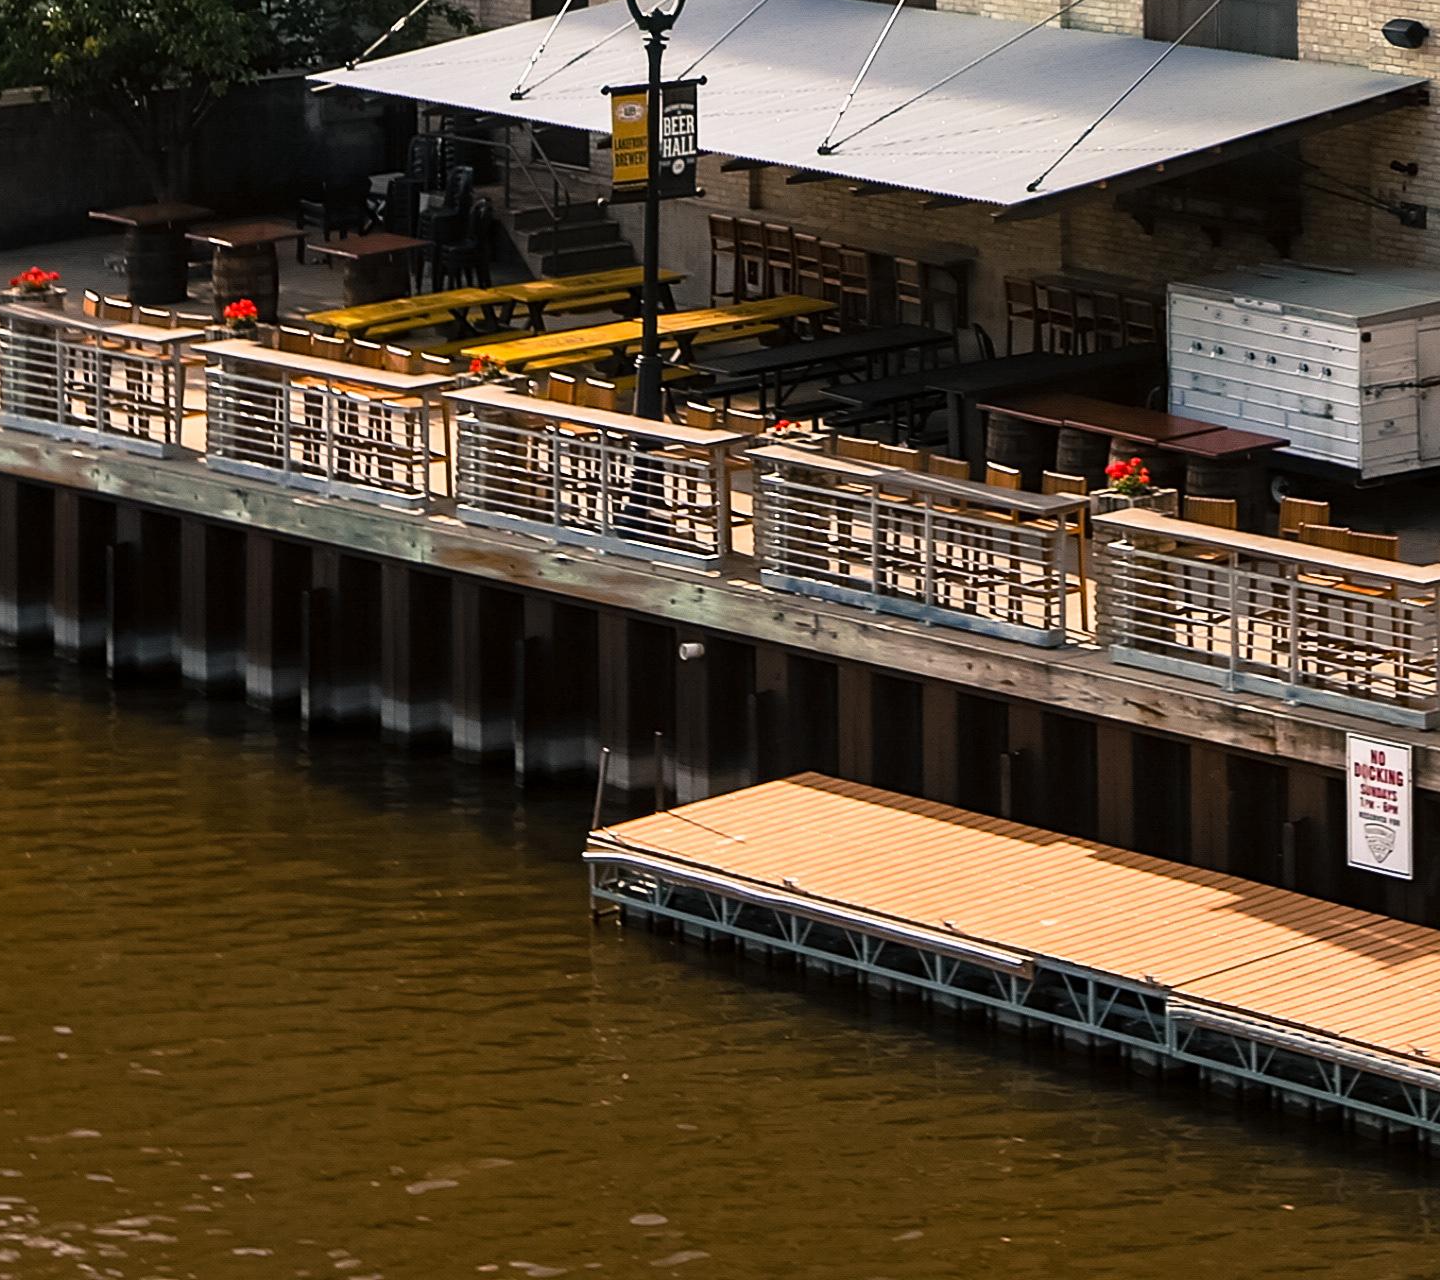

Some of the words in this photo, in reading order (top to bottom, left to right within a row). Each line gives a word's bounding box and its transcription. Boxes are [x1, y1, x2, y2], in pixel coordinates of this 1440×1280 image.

[663, 114, 695, 136] BEER
[662, 135, 697, 158] HALL
[1371, 749, 1386, 766] NO
[1354, 761, 1404, 787] DOCKING
